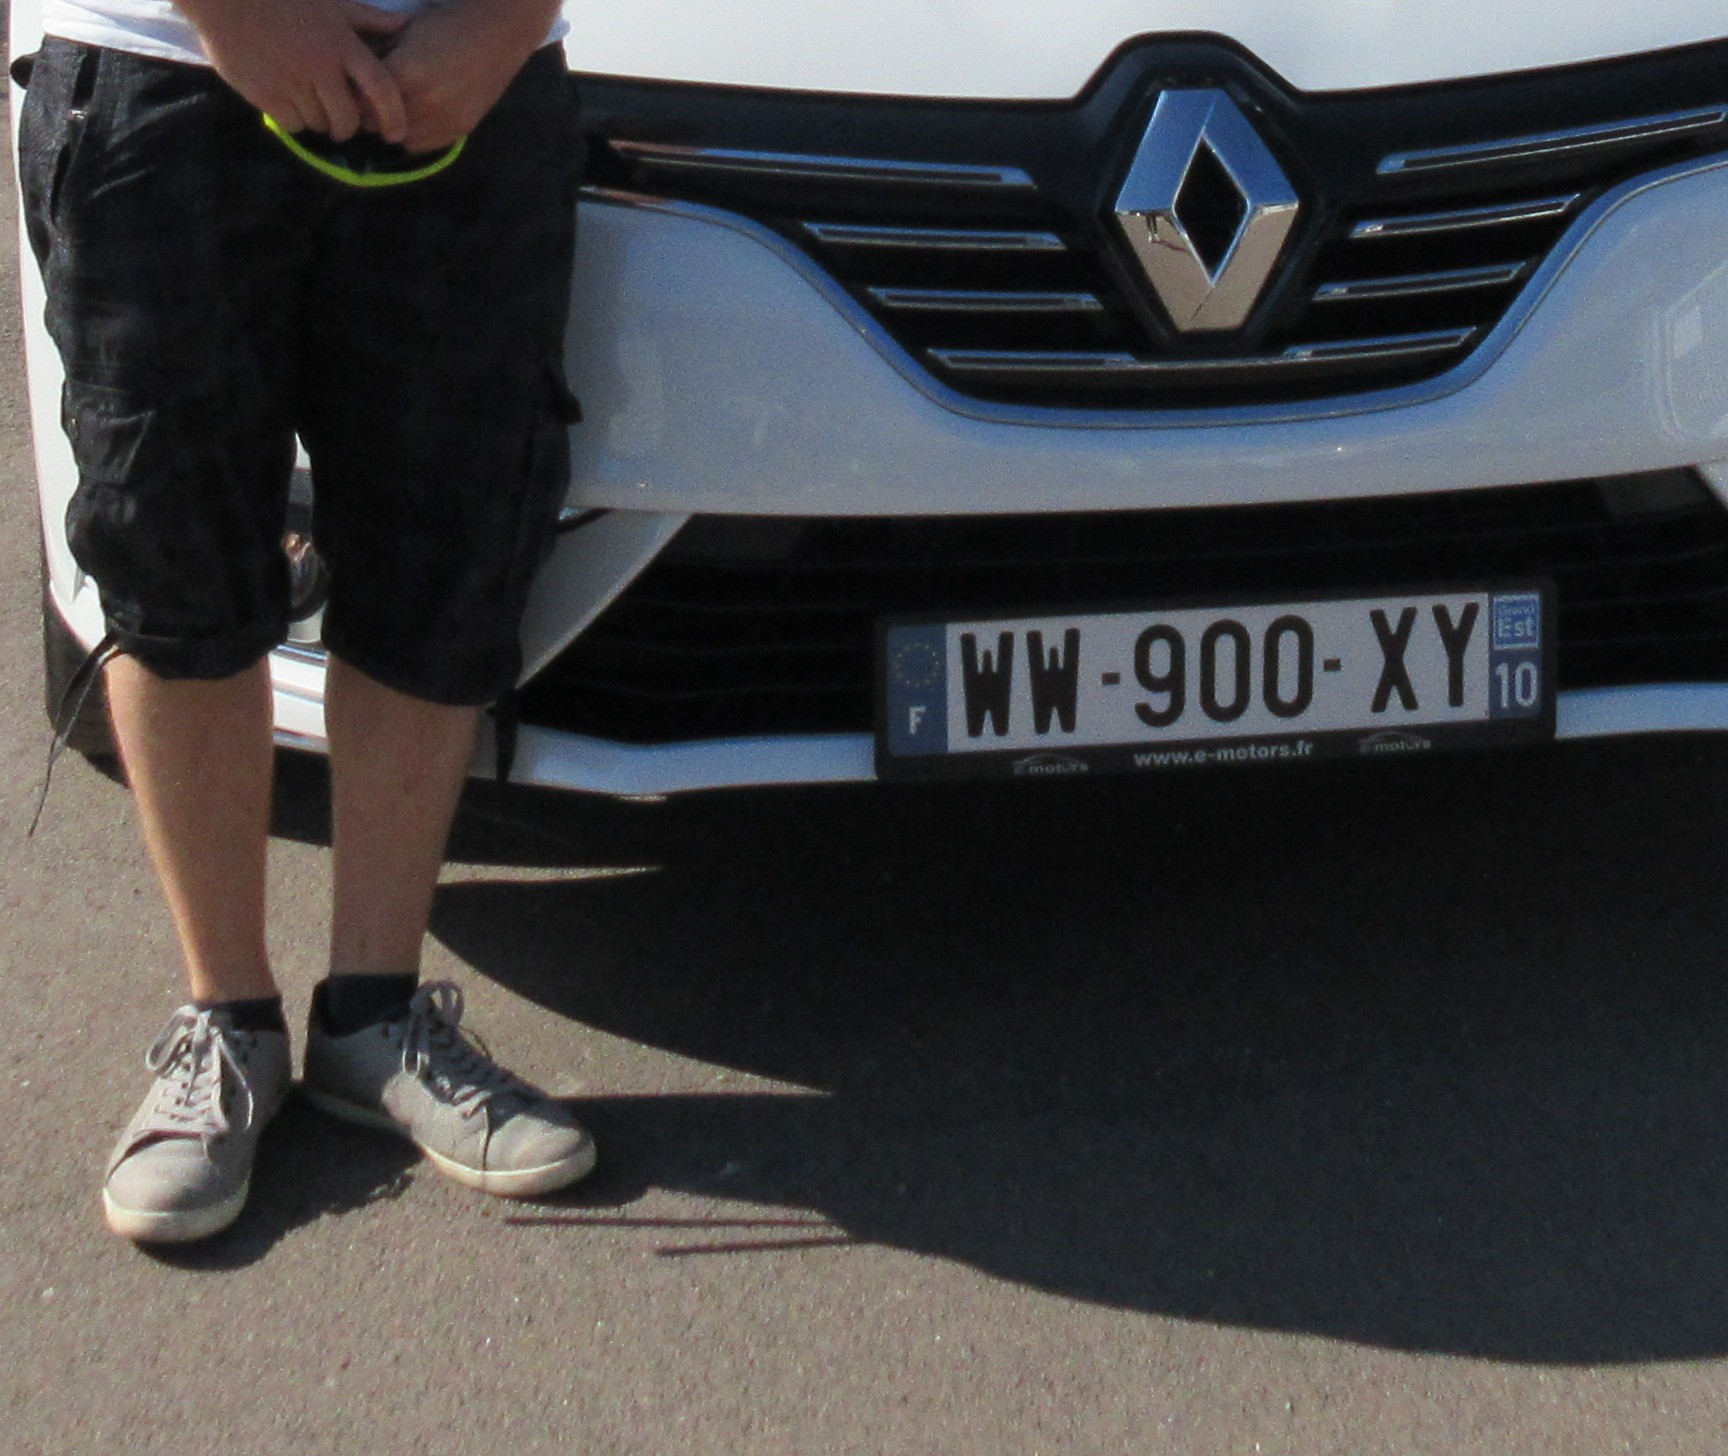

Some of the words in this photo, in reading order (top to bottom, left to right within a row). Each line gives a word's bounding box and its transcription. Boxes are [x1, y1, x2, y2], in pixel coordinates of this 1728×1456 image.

[1498, 616, 1534, 638] Est
[959, 601, 1480, 739] WW-900-XY
[1495, 661, 1538, 709] 10
[907, 705, 928, 735] F
[1134, 740, 1314, 768] www.e-motors.fr
